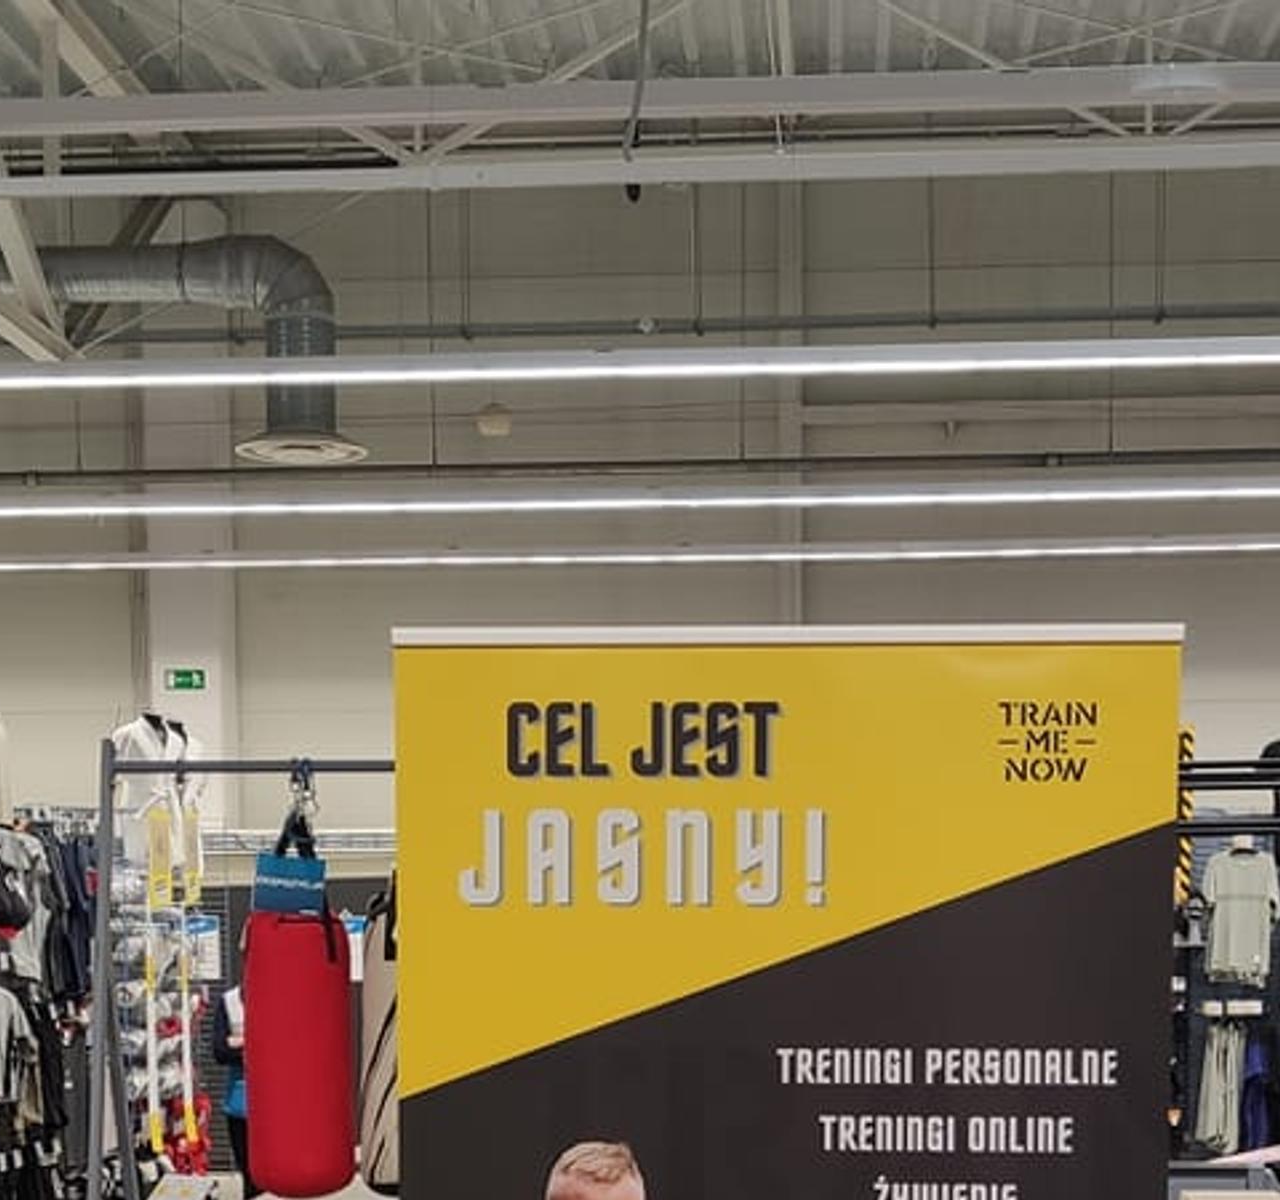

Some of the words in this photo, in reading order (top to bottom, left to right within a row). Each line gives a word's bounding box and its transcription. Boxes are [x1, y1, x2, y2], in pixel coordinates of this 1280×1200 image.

[998, 701, 1097, 726] TRAIN
[506, 701, 612, 777] CEL
[631, 701, 781, 778] JEST
[1025, 730, 1068, 753] ME
[1005, 758, 1087, 782] NOW
[459, 808, 828, 907] JASNY!
[776, 1048, 913, 1085] TRENINGI
[925, 1048, 1119, 1086] PERSONALNE
[819, 1115, 955, 1152] TRENINGI
[967, 1117, 1074, 1153] ONLINE
